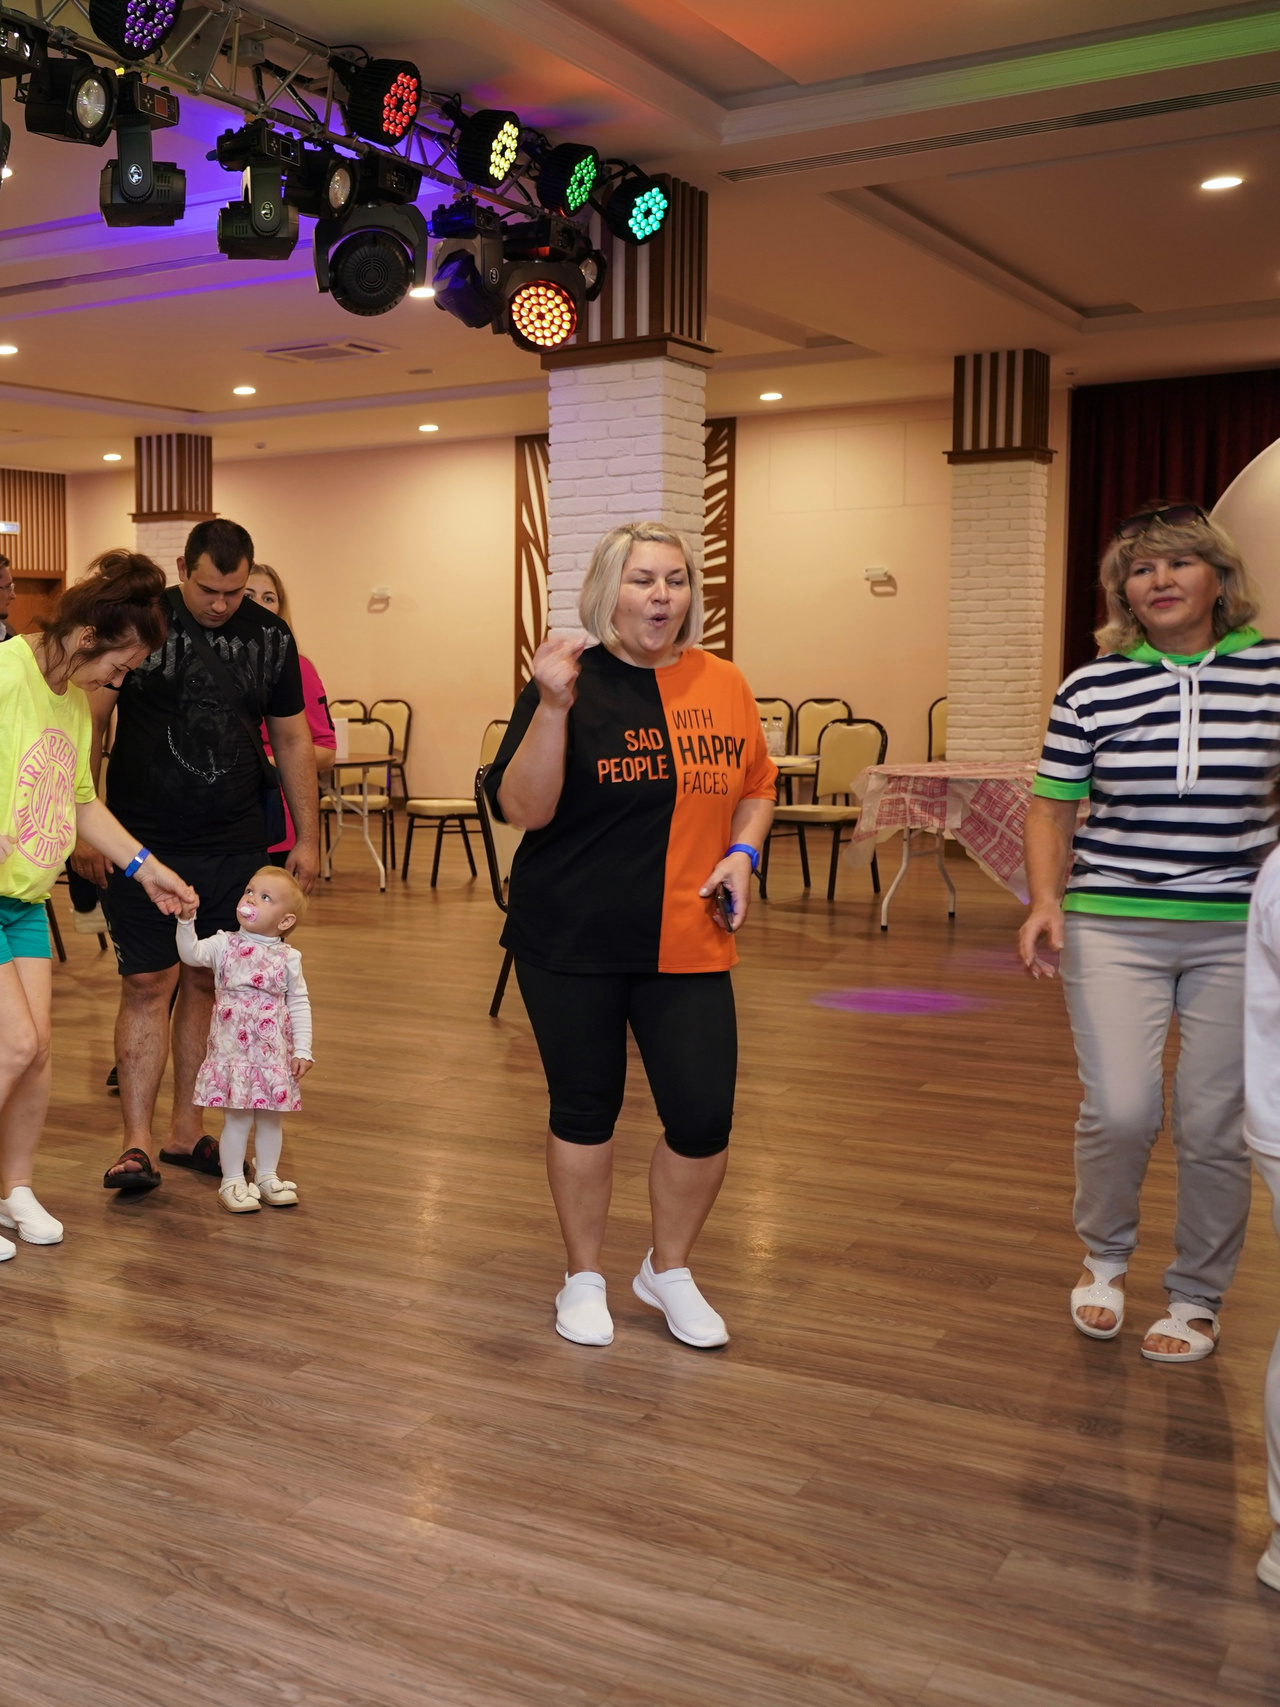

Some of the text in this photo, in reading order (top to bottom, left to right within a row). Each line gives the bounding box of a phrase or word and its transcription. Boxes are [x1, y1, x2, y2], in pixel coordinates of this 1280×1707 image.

[671, 708, 714, 730] WITH
[624, 727, 664, 752] SAD
[677, 735, 746, 769] HAPPY
[18, 742, 49, 787] TRU
[597, 754, 670, 784] PEOPLE
[683, 771, 729, 795] FACES
